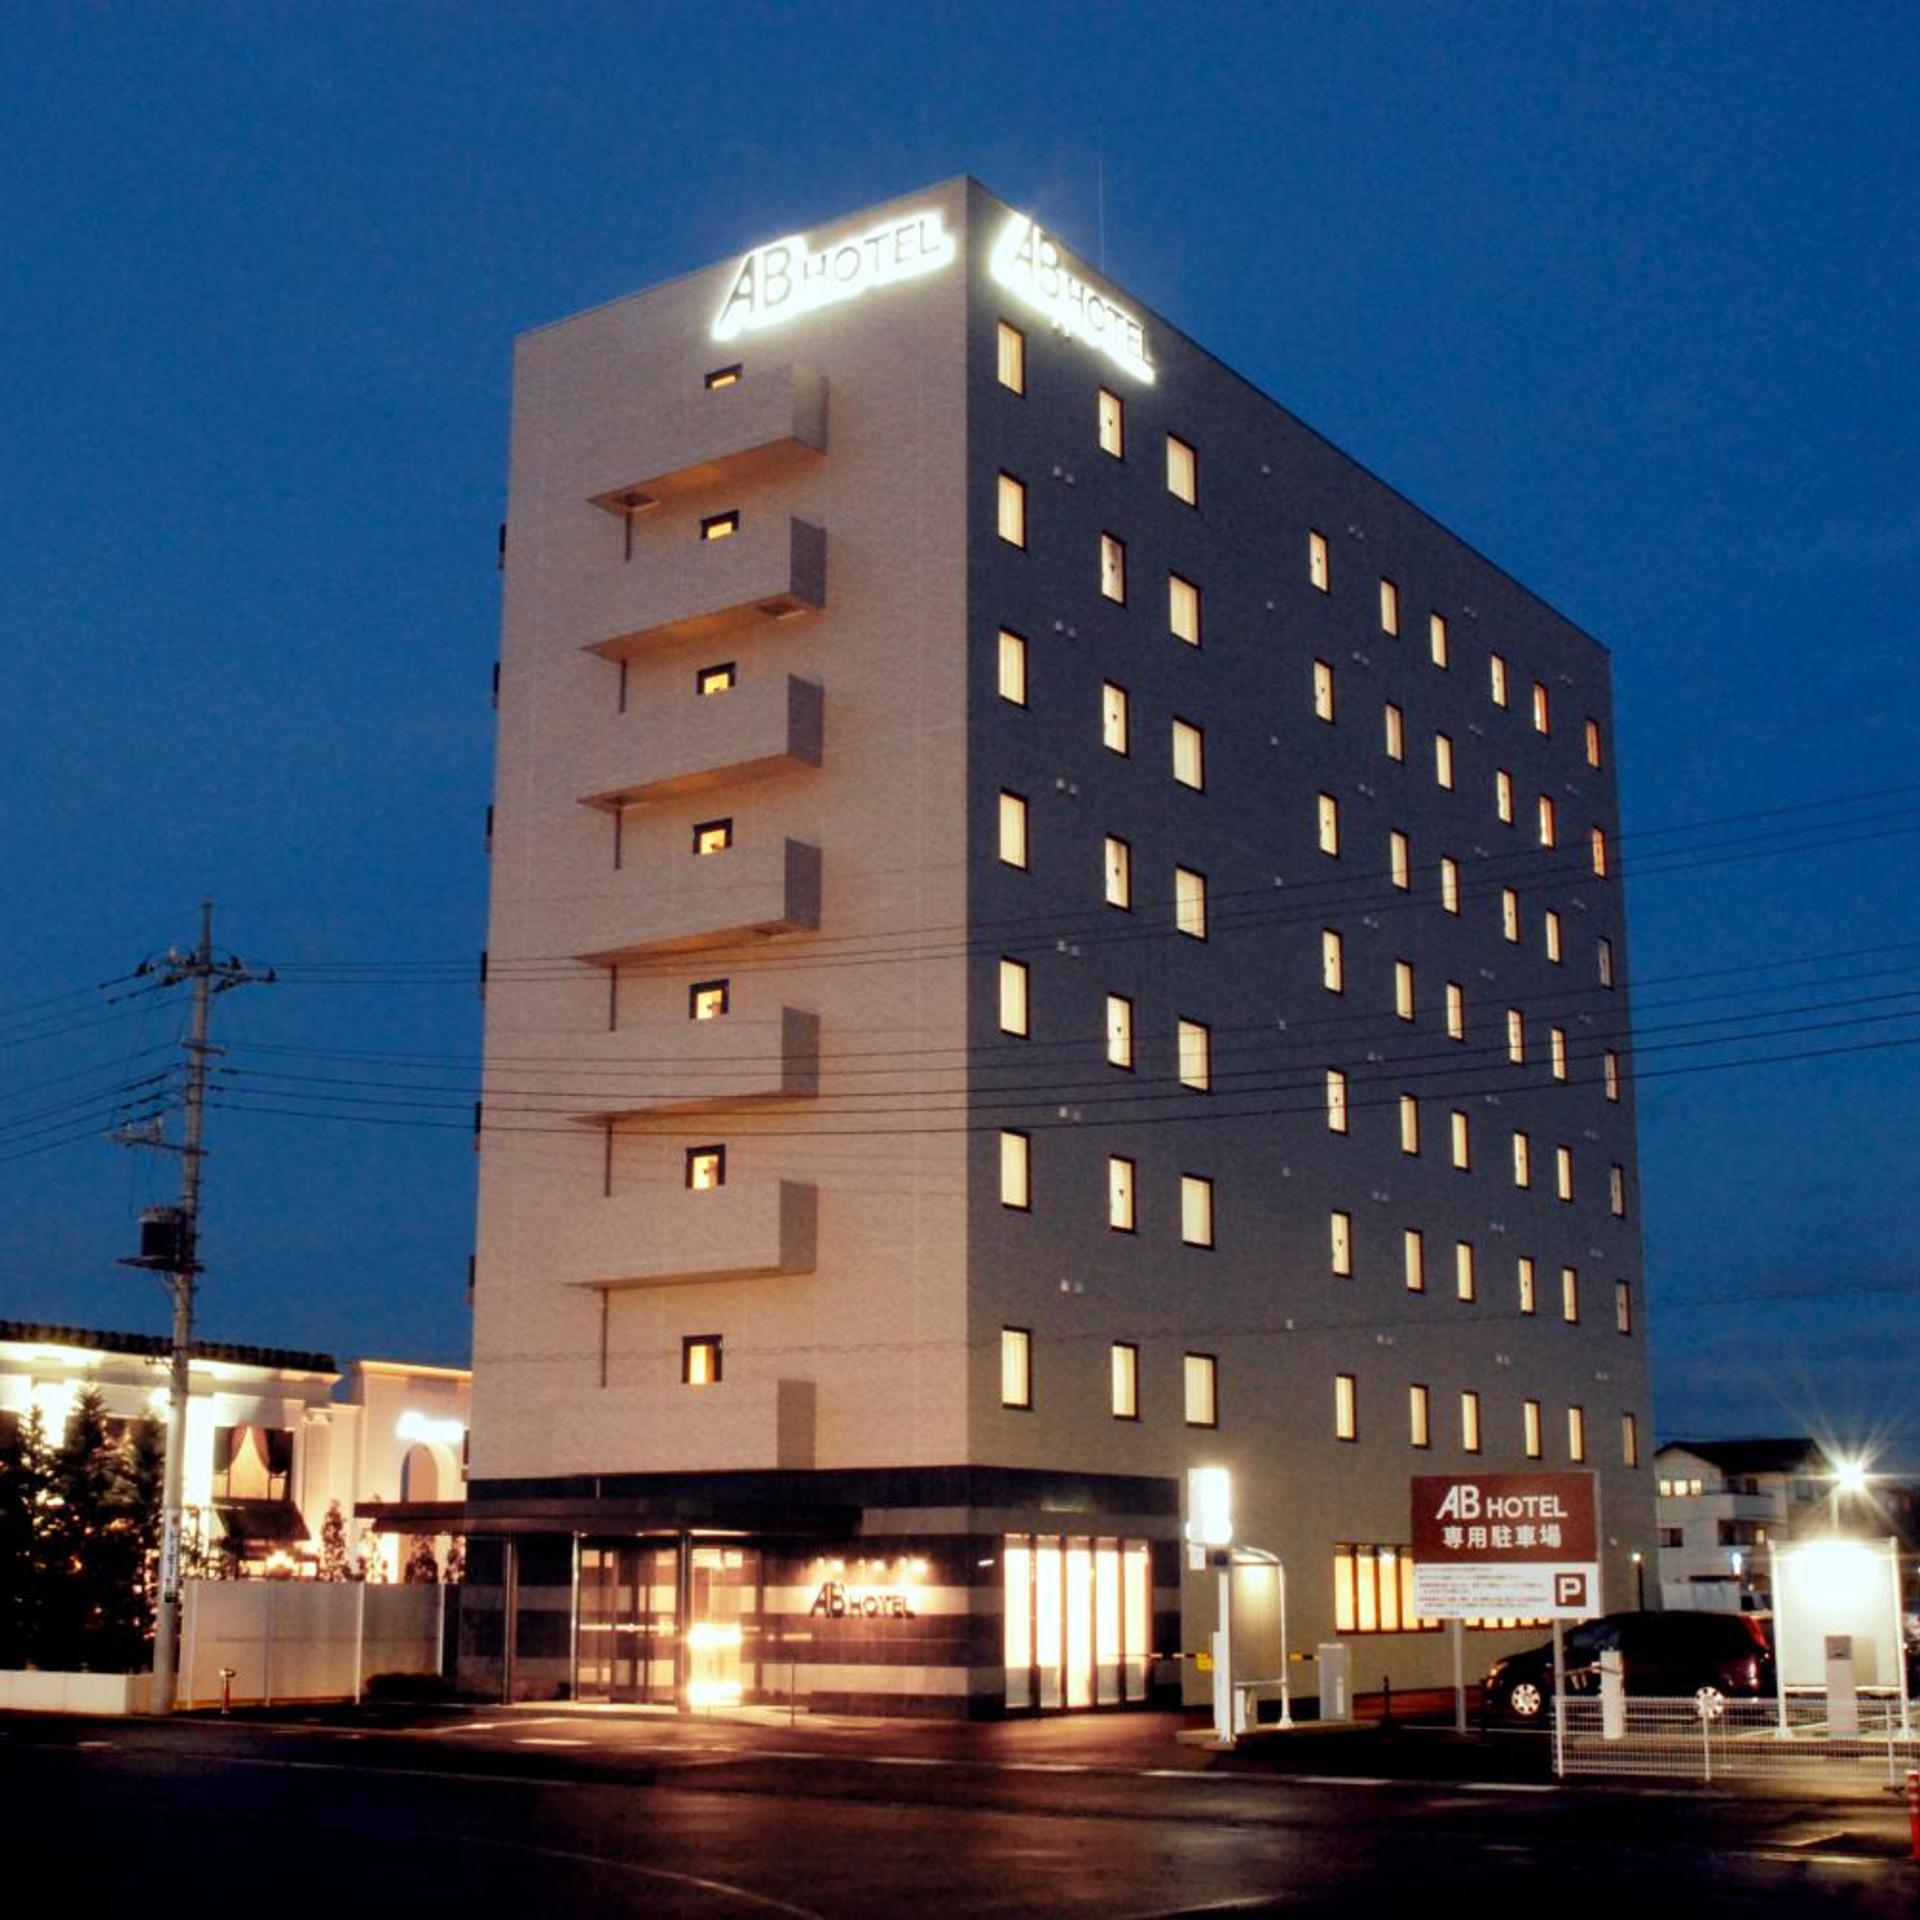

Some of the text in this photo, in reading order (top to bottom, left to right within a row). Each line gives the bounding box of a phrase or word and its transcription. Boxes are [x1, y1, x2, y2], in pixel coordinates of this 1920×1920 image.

[717, 218, 941, 325] AB HOTEL
[1435, 1484, 1568, 1520] AB HOTEL
[1442, 1523, 1562, 1549] 専用駐車場
[810, 1581, 916, 1618] AB HOTEL
[1559, 1577, 1582, 1604] P
